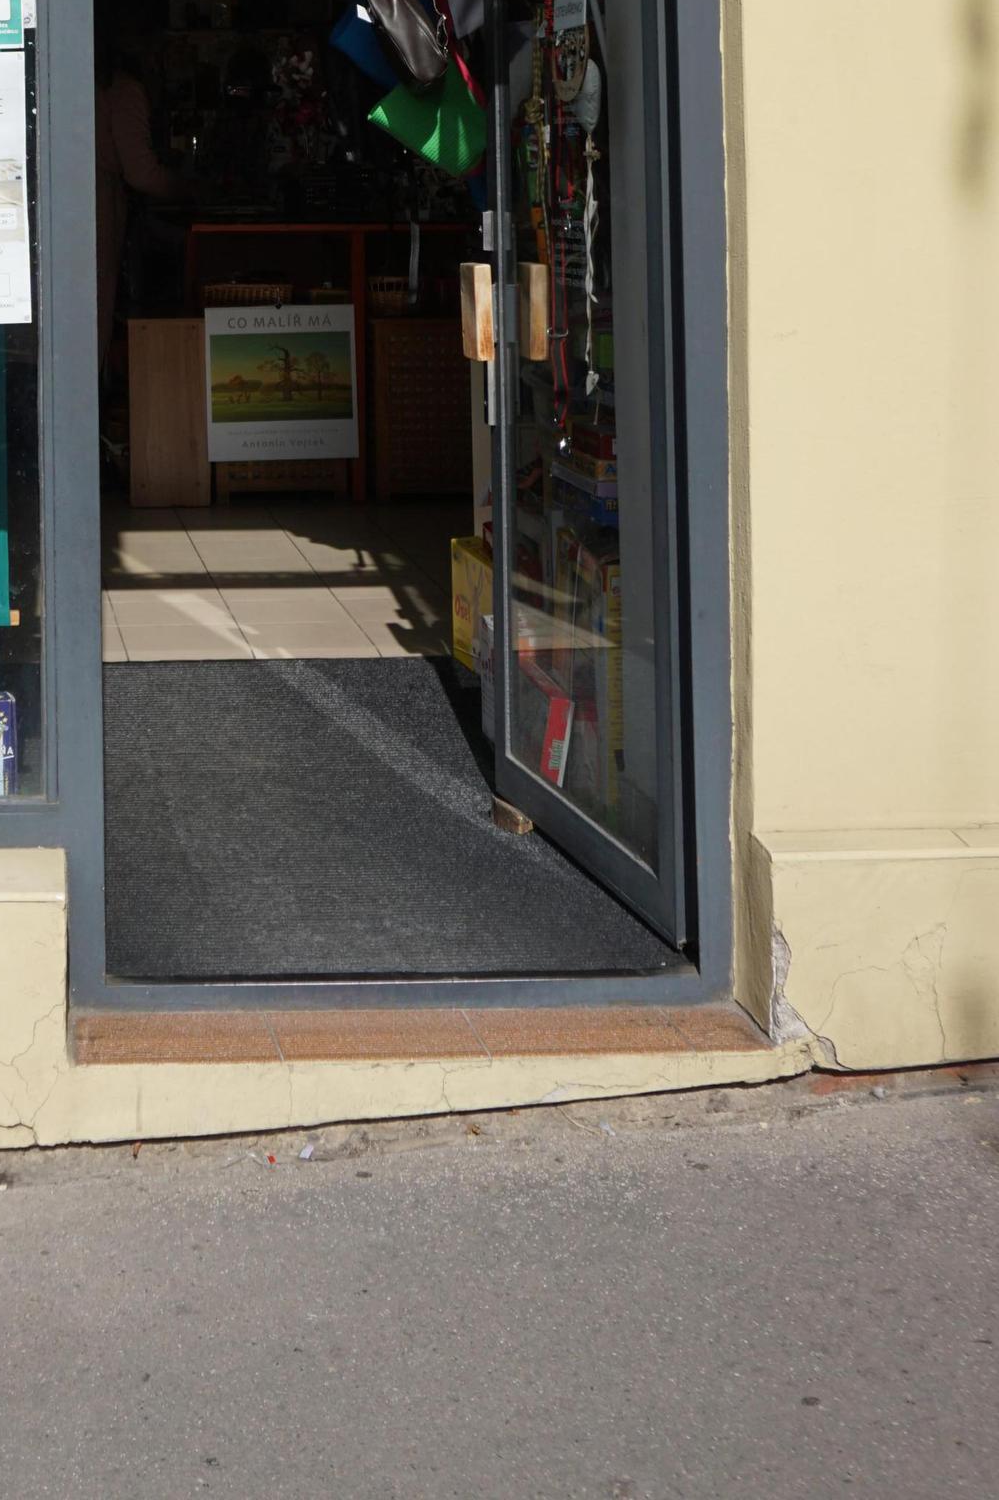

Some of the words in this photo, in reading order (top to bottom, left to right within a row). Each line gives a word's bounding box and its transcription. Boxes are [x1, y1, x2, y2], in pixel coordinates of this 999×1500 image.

[227, 317, 247, 329] CO
[253, 313, 302, 328] MALÍŘ
[308, 313, 332, 327] MÁ
